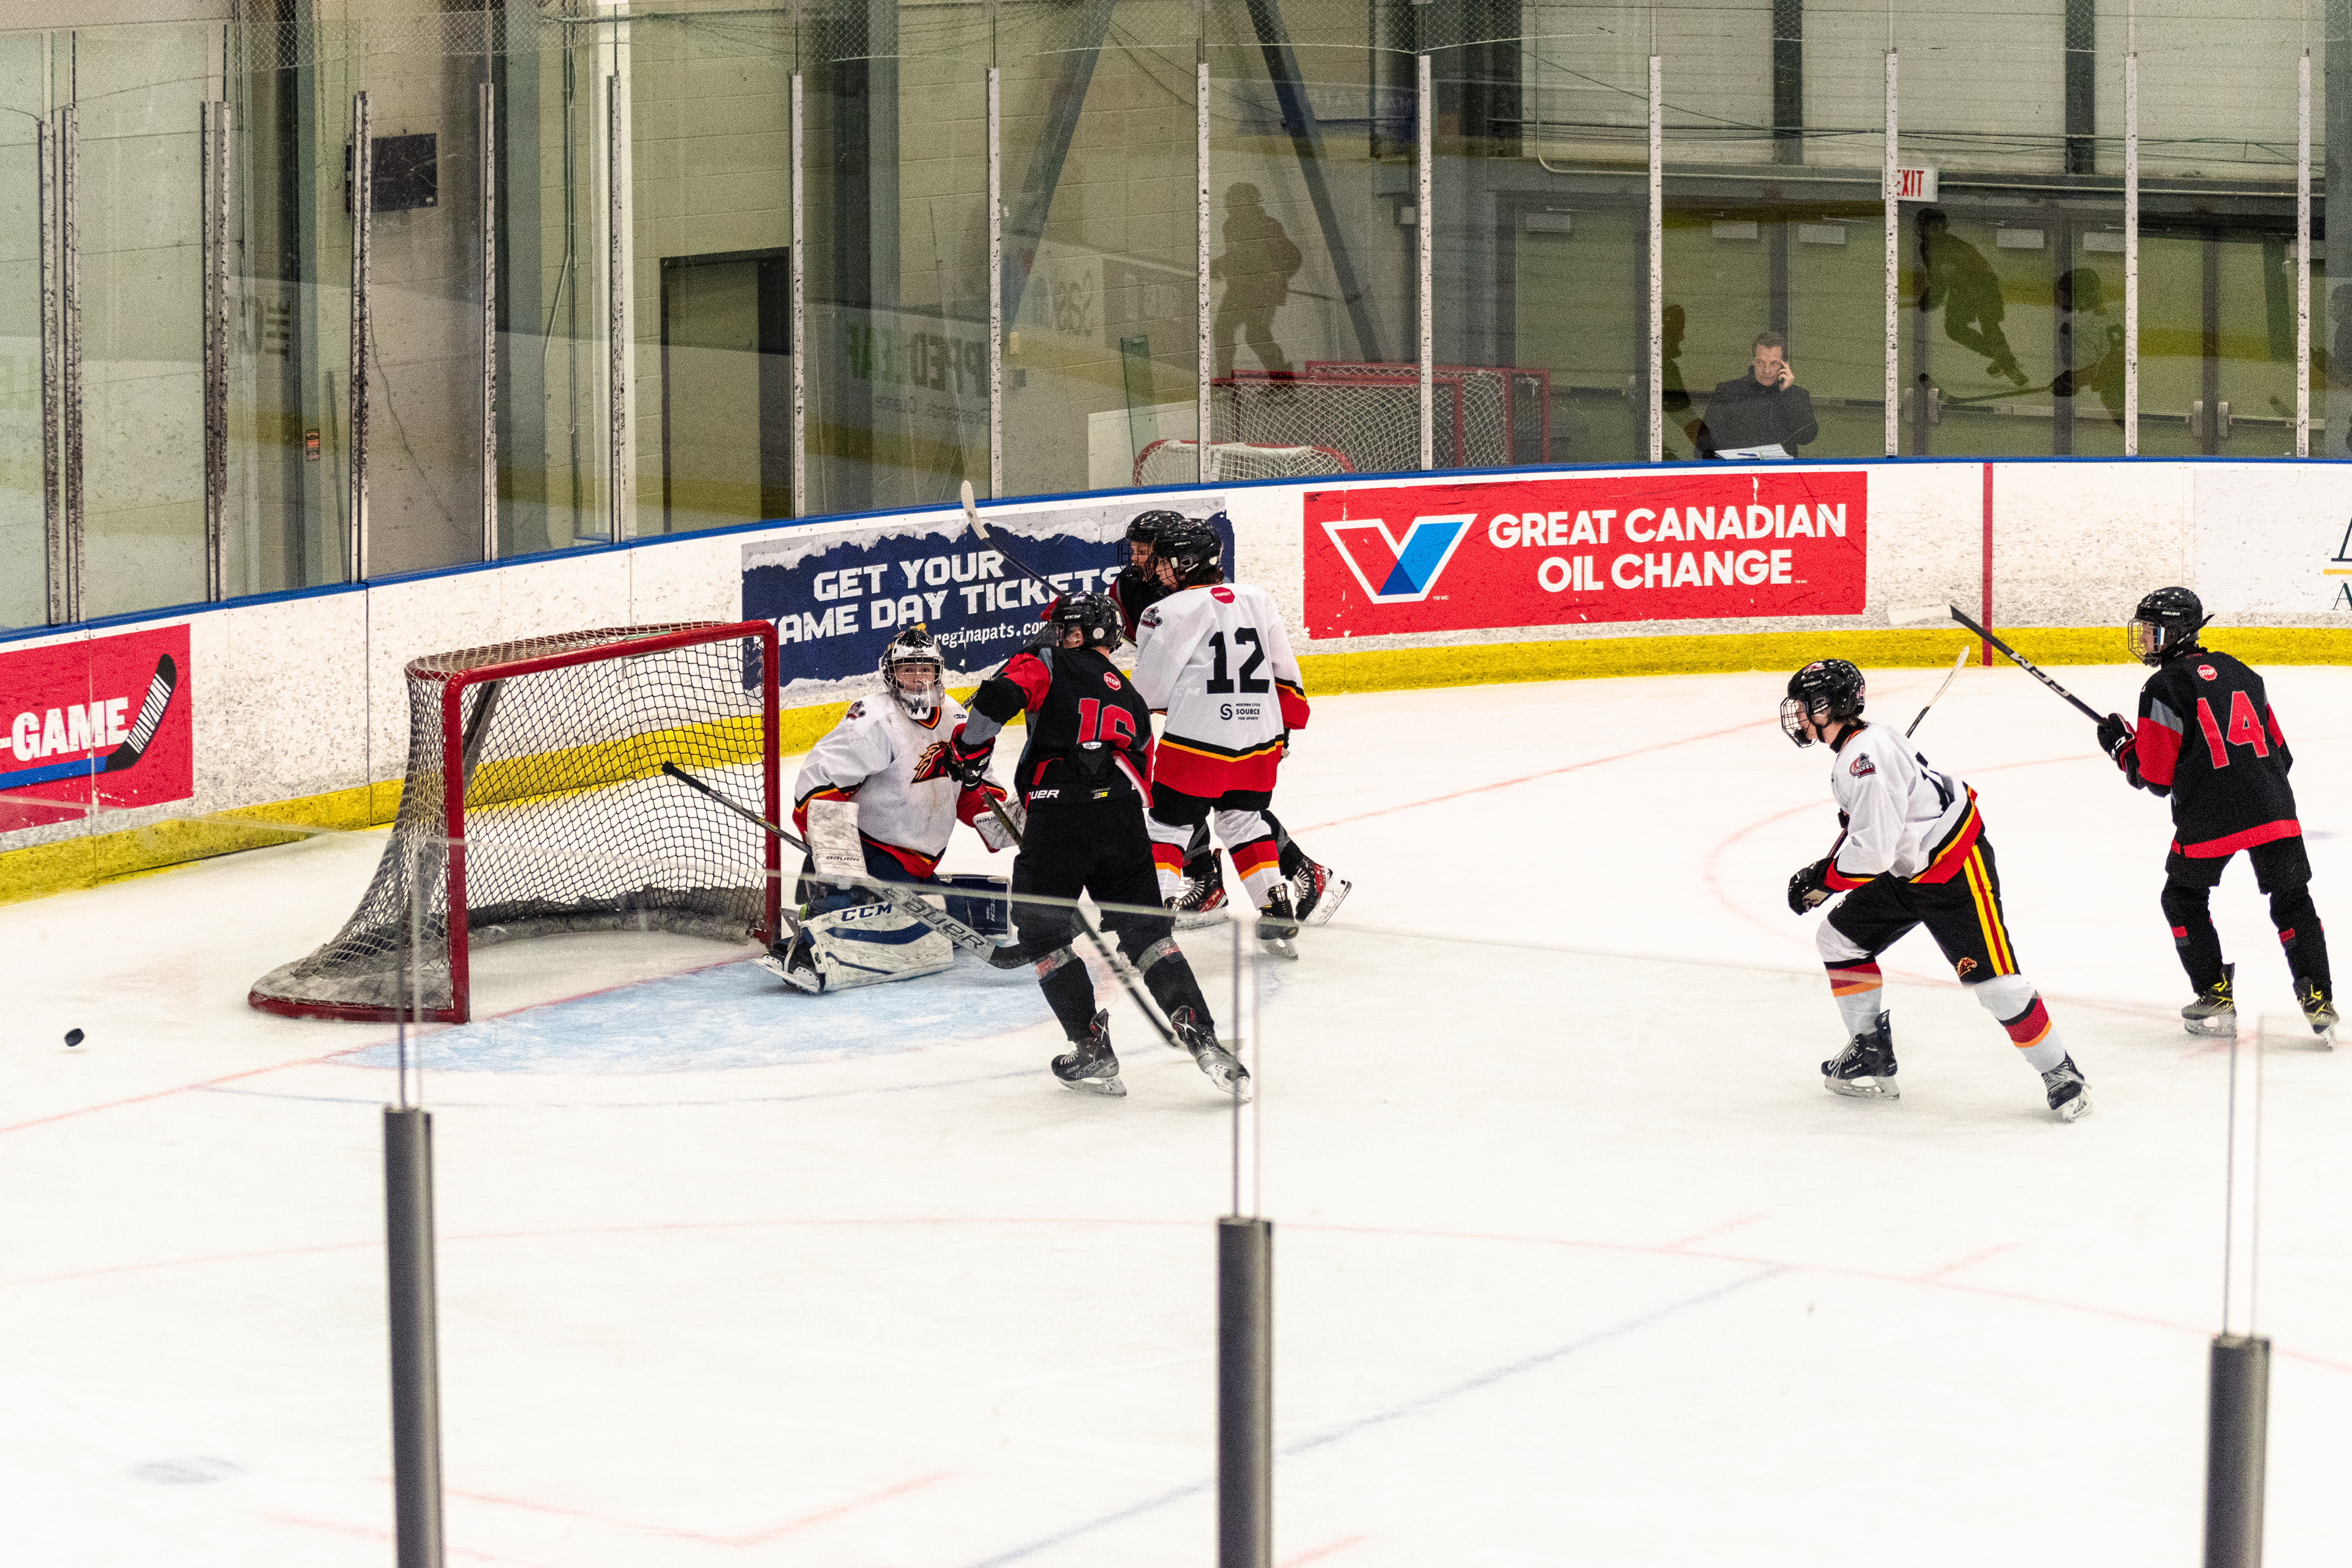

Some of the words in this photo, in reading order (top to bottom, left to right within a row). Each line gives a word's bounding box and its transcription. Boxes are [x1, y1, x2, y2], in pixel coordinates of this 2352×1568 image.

[1488, 510, 1616, 548] GREAT
[1624, 503, 1846, 543] CANADIAN
[813, 564, 888, 601] GET
[899, 550, 1005, 589] YOUR
[1537, 556, 1604, 592] OIL
[1611, 549, 1792, 589] CHANGE
[765, 604, 858, 646] AME
[870, 590, 948, 630] DAY
[960, 564, 1126, 614] TICKETS
[933, 621, 1048, 648] reginapats.com
[1105, 676, 1119, 686] STOP
[1207, 627, 1270, 694] 12
[1076, 698, 1136, 752] 16
[2196, 690, 2269, 769] 14
[1030, 790, 1059, 799] UER
[841, 903, 892, 922] CCM
